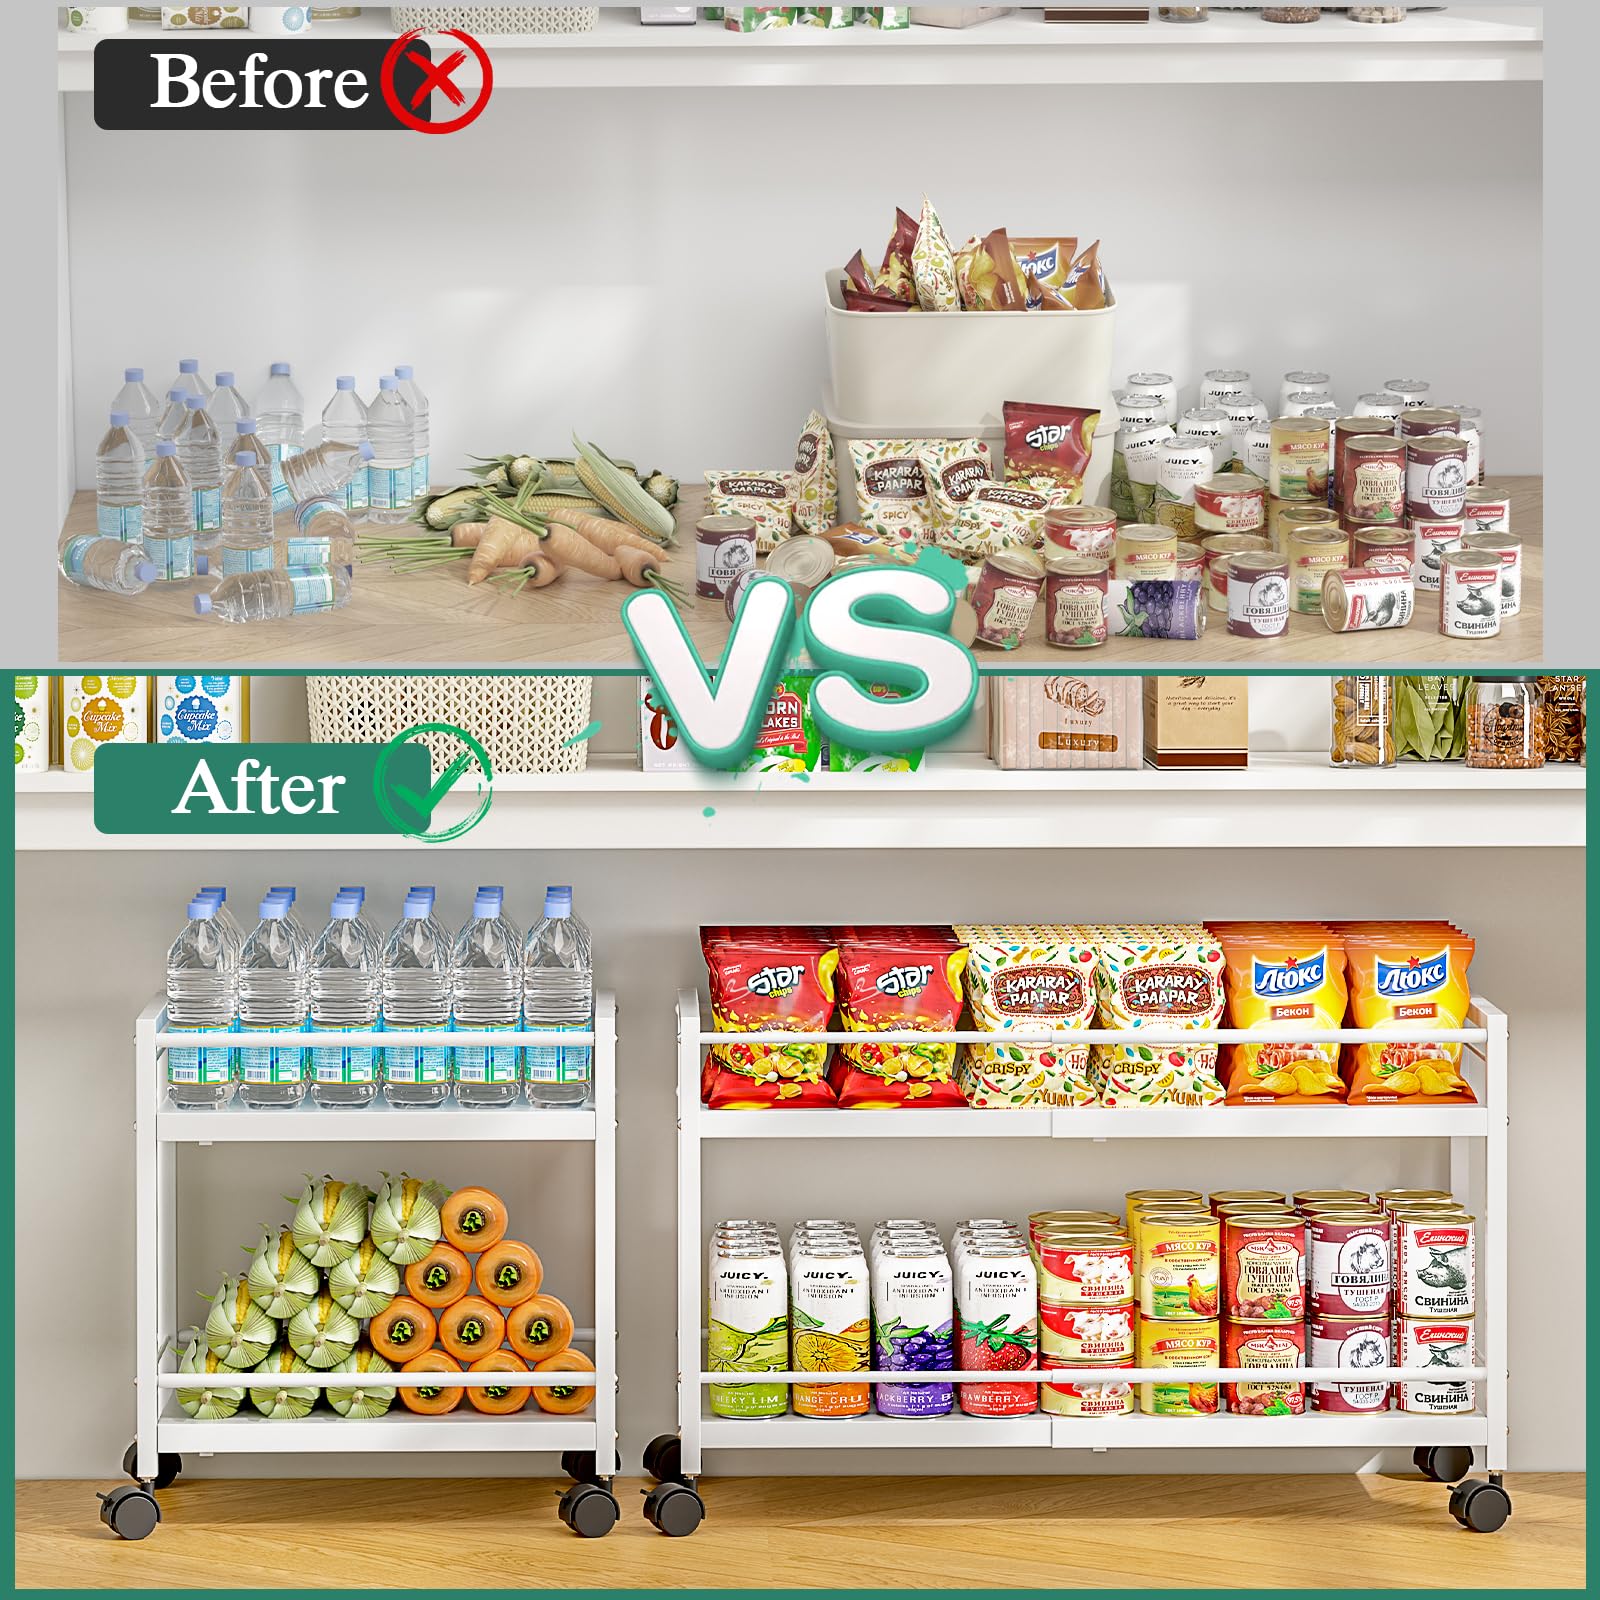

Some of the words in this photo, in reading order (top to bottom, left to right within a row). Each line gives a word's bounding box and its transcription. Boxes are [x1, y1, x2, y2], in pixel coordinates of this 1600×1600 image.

[737, 502, 763, 511] SPICY
[980, 506, 1008, 517] SPICY
[882, 510, 909, 523] SPICY
[1135, 554, 1158, 562] МЯСО
[1308, 556, 1331, 564] МЯСО
[83, 710, 122, 724] Cupcake
[178, 708, 216, 722] Cupcake
[94, 721, 117, 733] Mix
[187, 720, 212, 732] Mix
[1057, 735, 1100, 748] Luxury
[1006, 975, 1076, 993] KARARAY
[1135, 975, 1204, 993] KARARAY
[768, 987, 794, 999] chips
[897, 987, 923, 999] chips
[1010, 990, 1069, 1006] PAAPAR
[1139, 990, 1198, 1006] PAAPAR
[1276, 1006, 1310, 1018] Бекон
[1399, 1006, 1433, 1017] Бекон
[1165, 1242, 1194, 1251] МЯСО
[1195, 1242, 1213, 1251] КУР
[1344, 1288, 1384, 1296] ТУШЕНАЯ
[1415, 1295, 1469, 1306] СВИНИНА
[1165, 1339, 1194, 1349] МЯСО
[1195, 1339, 1213, 1348] КУР
[1344, 1385, 1384, 1393] ТУШЕНАЯ
[1415, 1392, 1469, 1403] СВИНИНА
